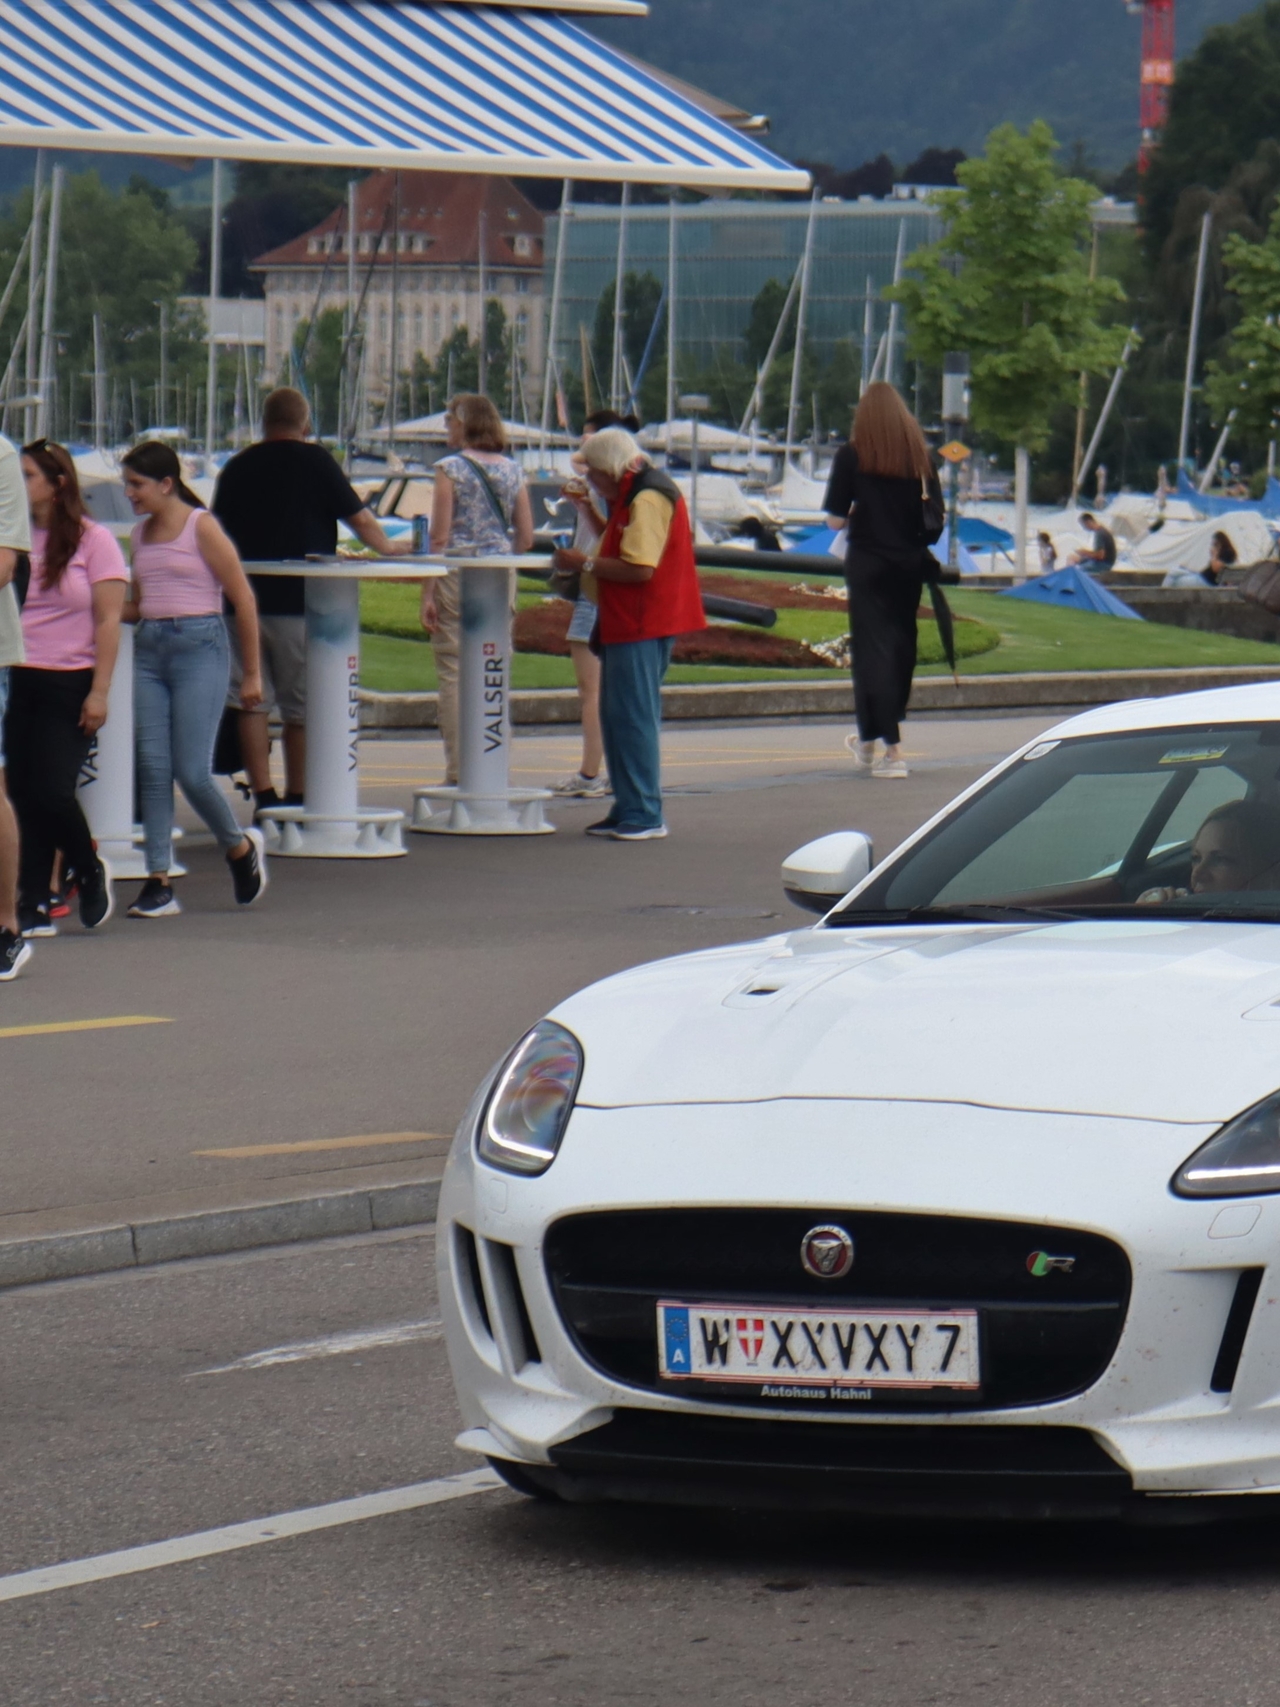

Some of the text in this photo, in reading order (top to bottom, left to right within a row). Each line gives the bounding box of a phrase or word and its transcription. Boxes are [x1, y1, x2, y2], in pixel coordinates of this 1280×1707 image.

[484, 657, 503, 754] VALSER
[672, 1349, 685, 1364] A
[761, 1385, 827, 1399] Autohaus
